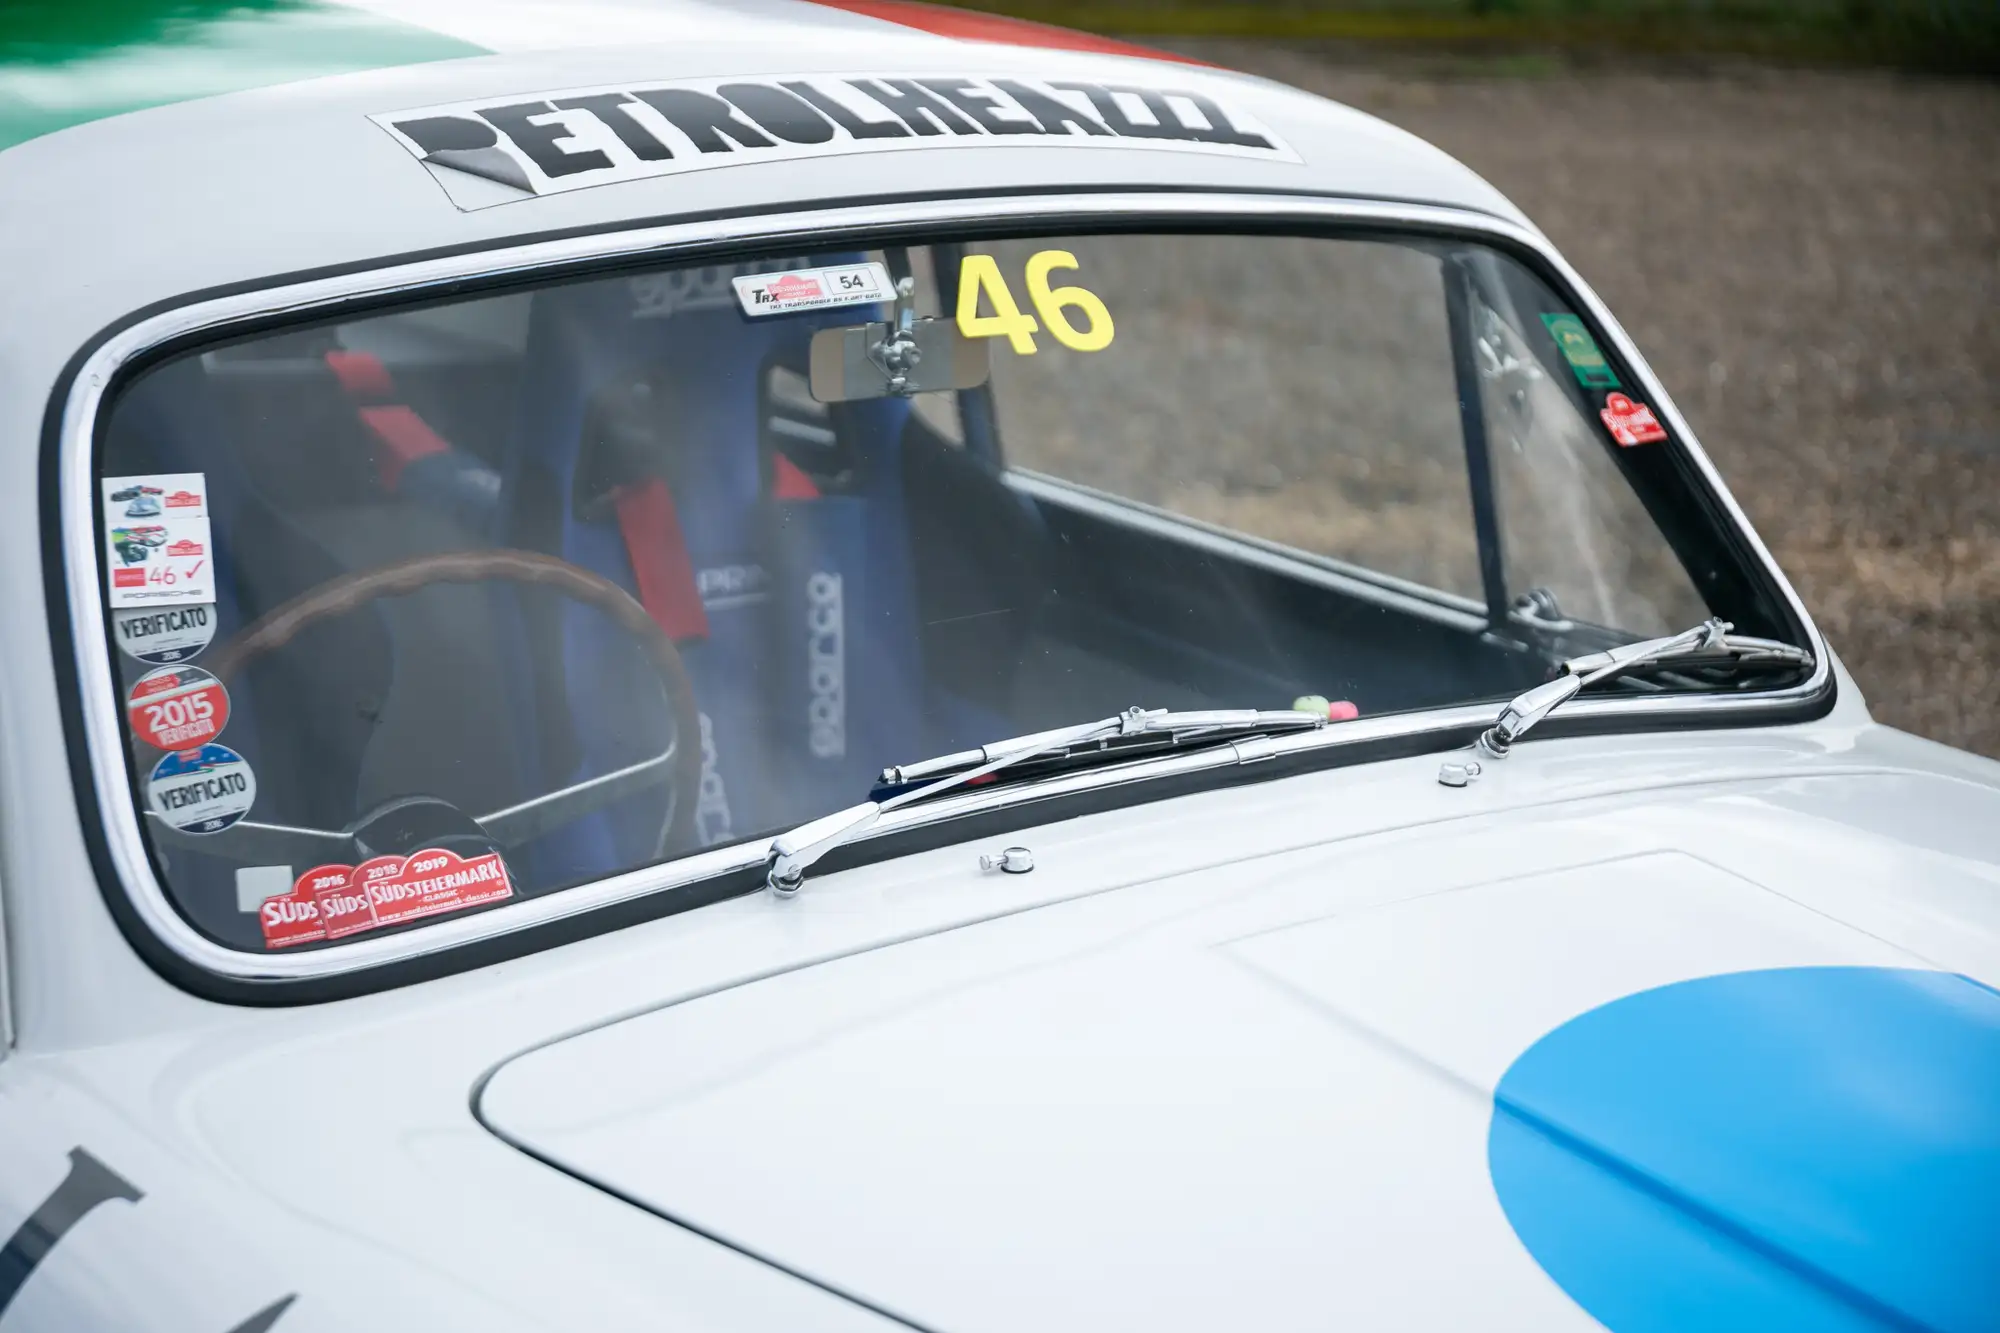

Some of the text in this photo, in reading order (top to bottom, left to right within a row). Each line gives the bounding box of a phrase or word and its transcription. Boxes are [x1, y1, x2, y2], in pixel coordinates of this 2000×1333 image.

[840, 274, 864, 290] 54
[956, 250, 1115, 355] 46
[148, 566, 176, 585] 46
[122, 589, 203, 599] PORSCHE
[120, 607, 208, 640] VERIFICATO
[144, 692, 214, 733] 2015
[157, 719, 216, 746] VERIFICATO
[157, 772, 247, 811] VERIFICATO
[367, 863, 399, 880] 2018
[412, 856, 449, 873] 2019
[313, 873, 346, 889] 2016
[370, 859, 501, 905] SÜDSTEIERMARK
